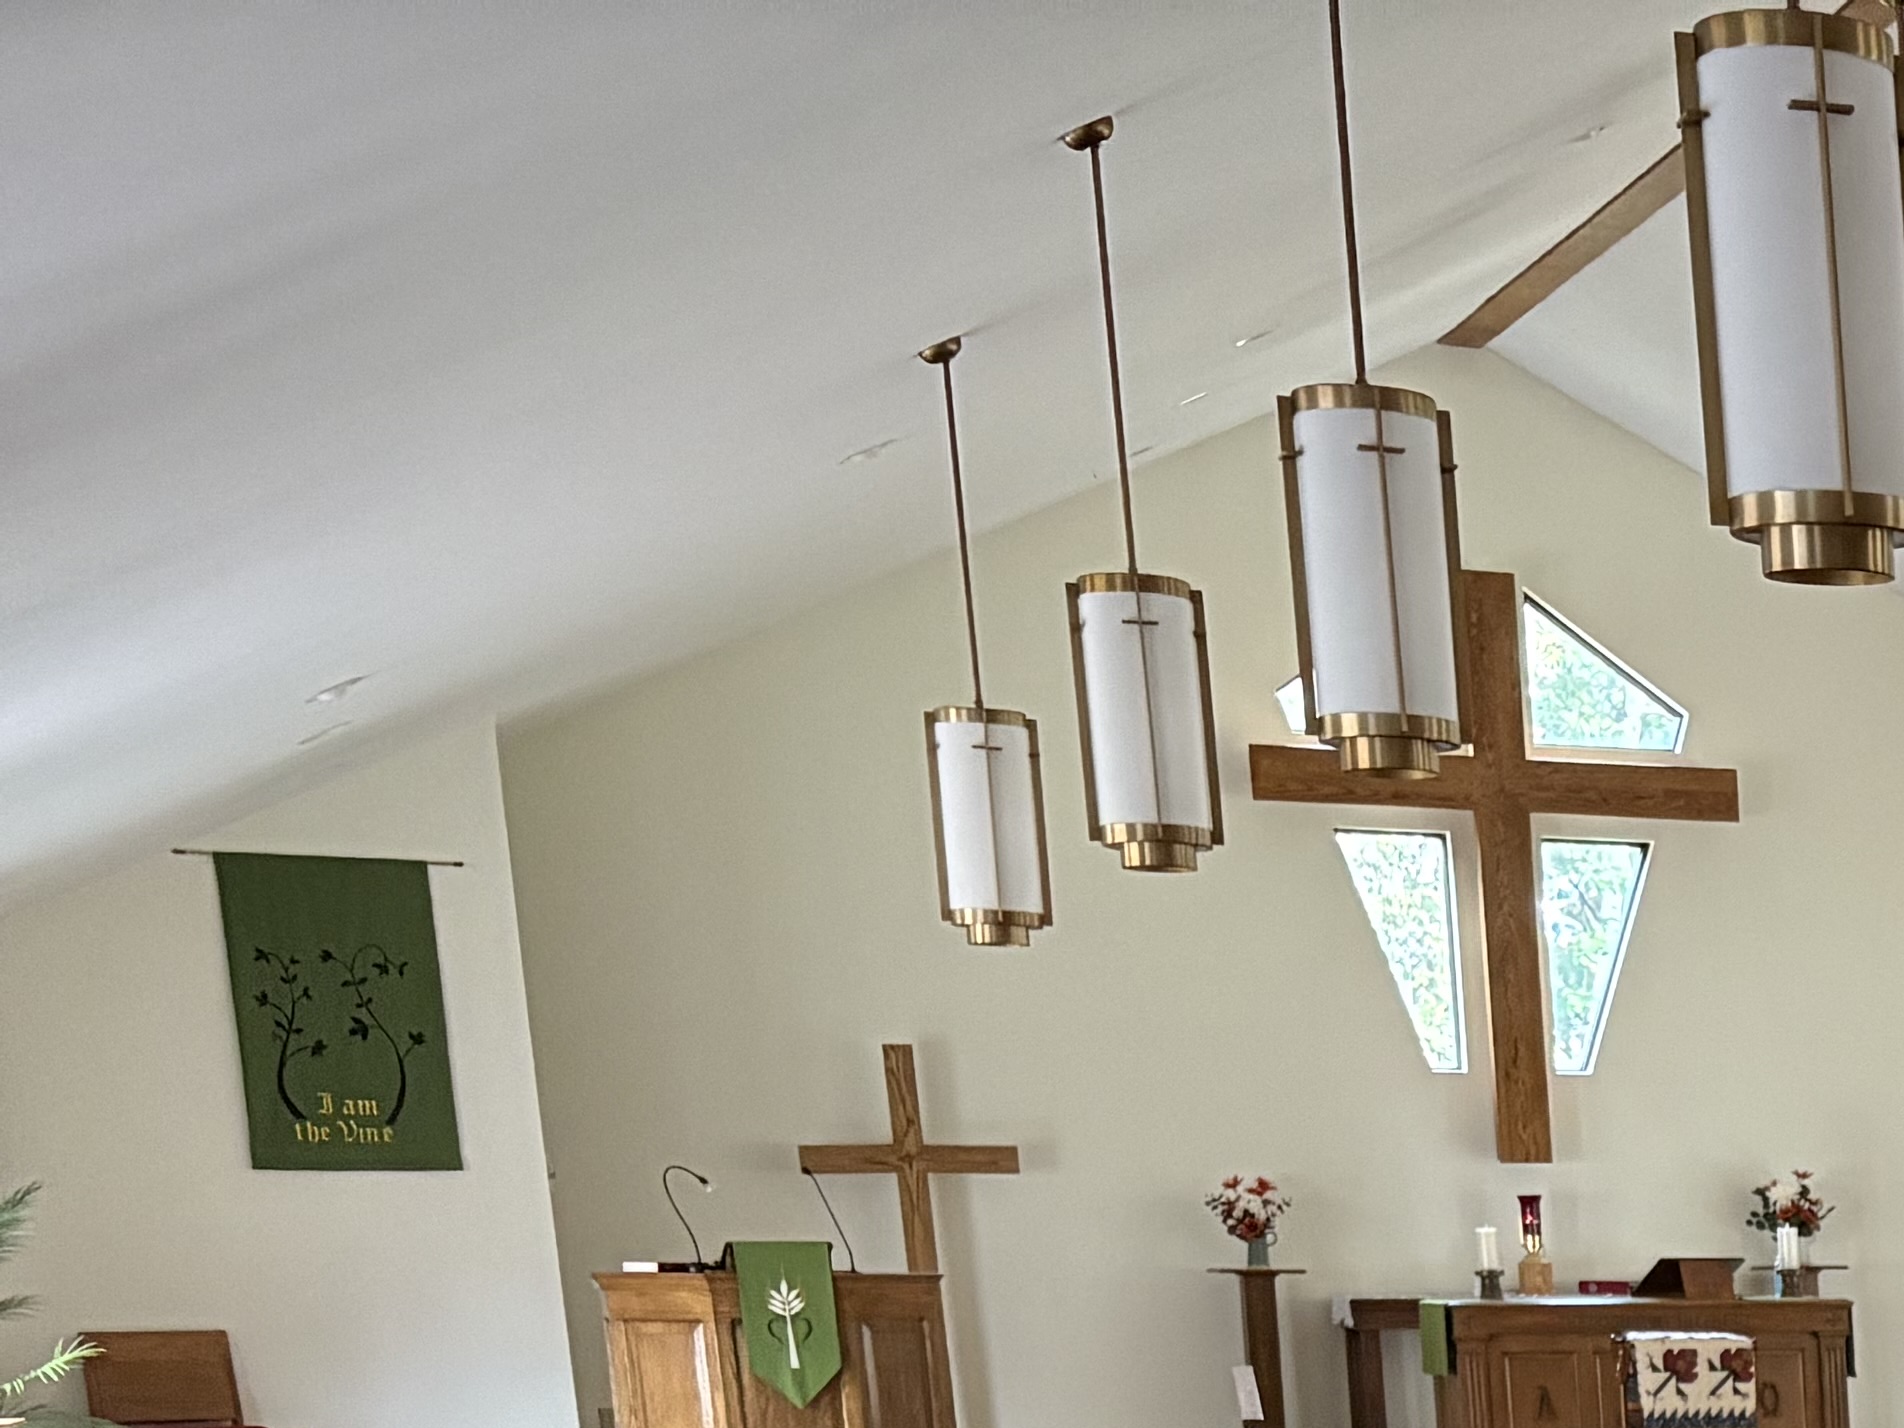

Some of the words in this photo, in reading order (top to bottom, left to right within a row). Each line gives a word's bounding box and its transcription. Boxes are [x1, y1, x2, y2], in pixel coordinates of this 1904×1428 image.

[317, 1092, 333, 1115] I
[343, 1099, 378, 1116] am
[295, 1121, 330, 1142] the
[336, 1120, 394, 1143] Vine
